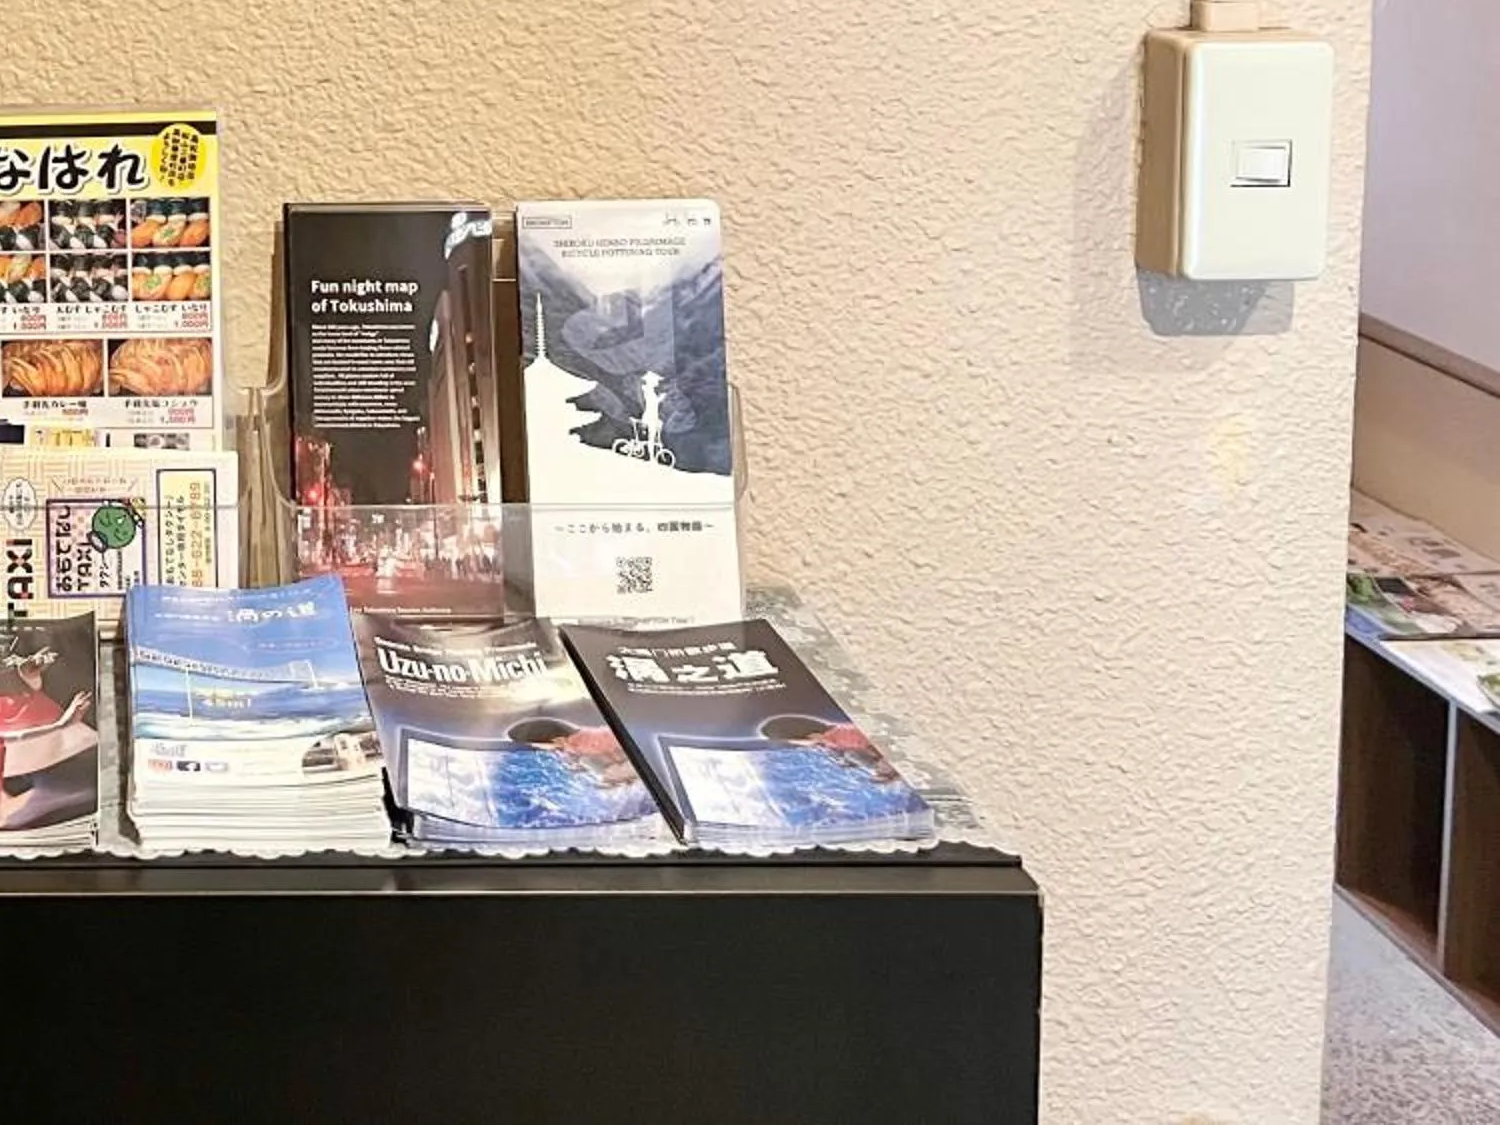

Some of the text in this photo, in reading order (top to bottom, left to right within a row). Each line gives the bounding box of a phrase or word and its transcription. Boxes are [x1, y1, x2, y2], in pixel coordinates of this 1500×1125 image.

[311, 279, 419, 298] Fun night map
[311, 298, 413, 313] of Tokushima
